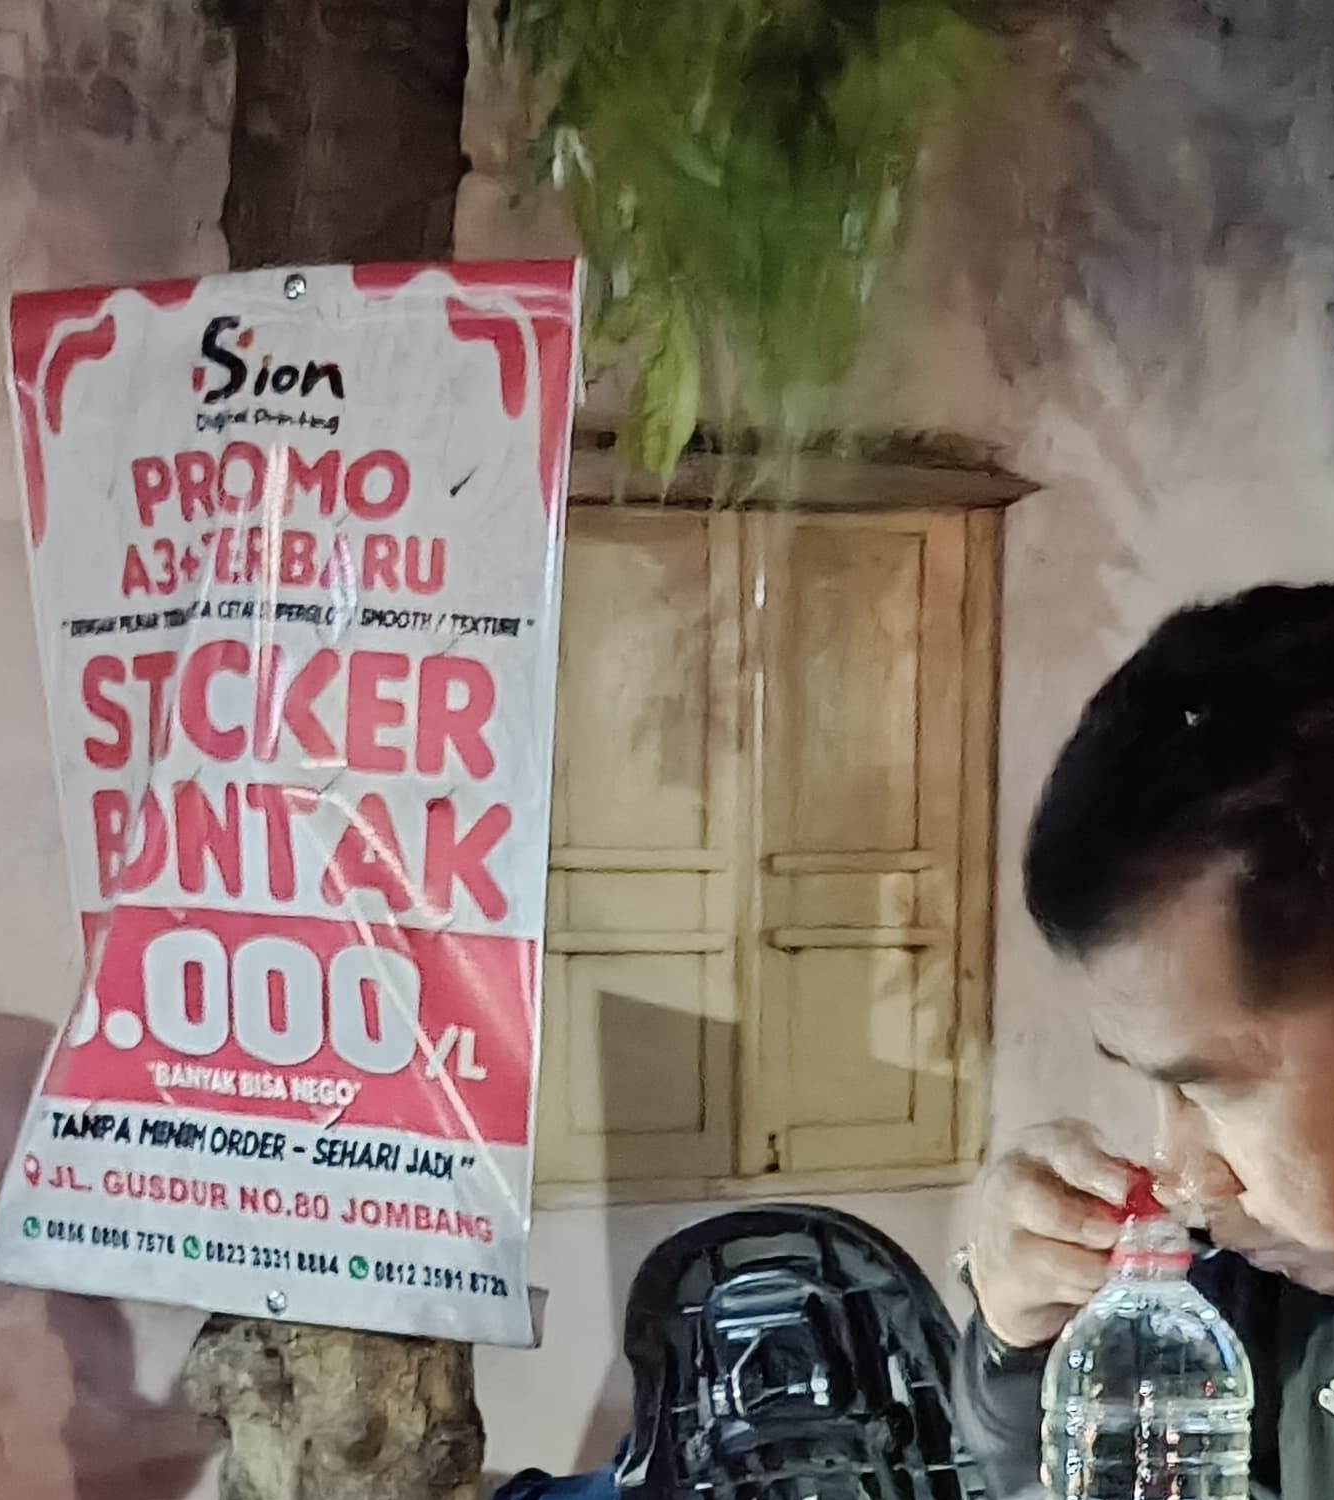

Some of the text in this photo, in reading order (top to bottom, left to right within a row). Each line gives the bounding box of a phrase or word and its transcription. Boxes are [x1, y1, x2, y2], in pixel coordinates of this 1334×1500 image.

[193, 315, 345, 404] Sion
[132, 441, 410, 526] PROMO
[210, 1125, 286, 1161] ORDER
[312, 1137, 400, 1172] SEHARI
[48, 1165, 494, 1243] JL. GUSDUR NO.80 JOMBANG
